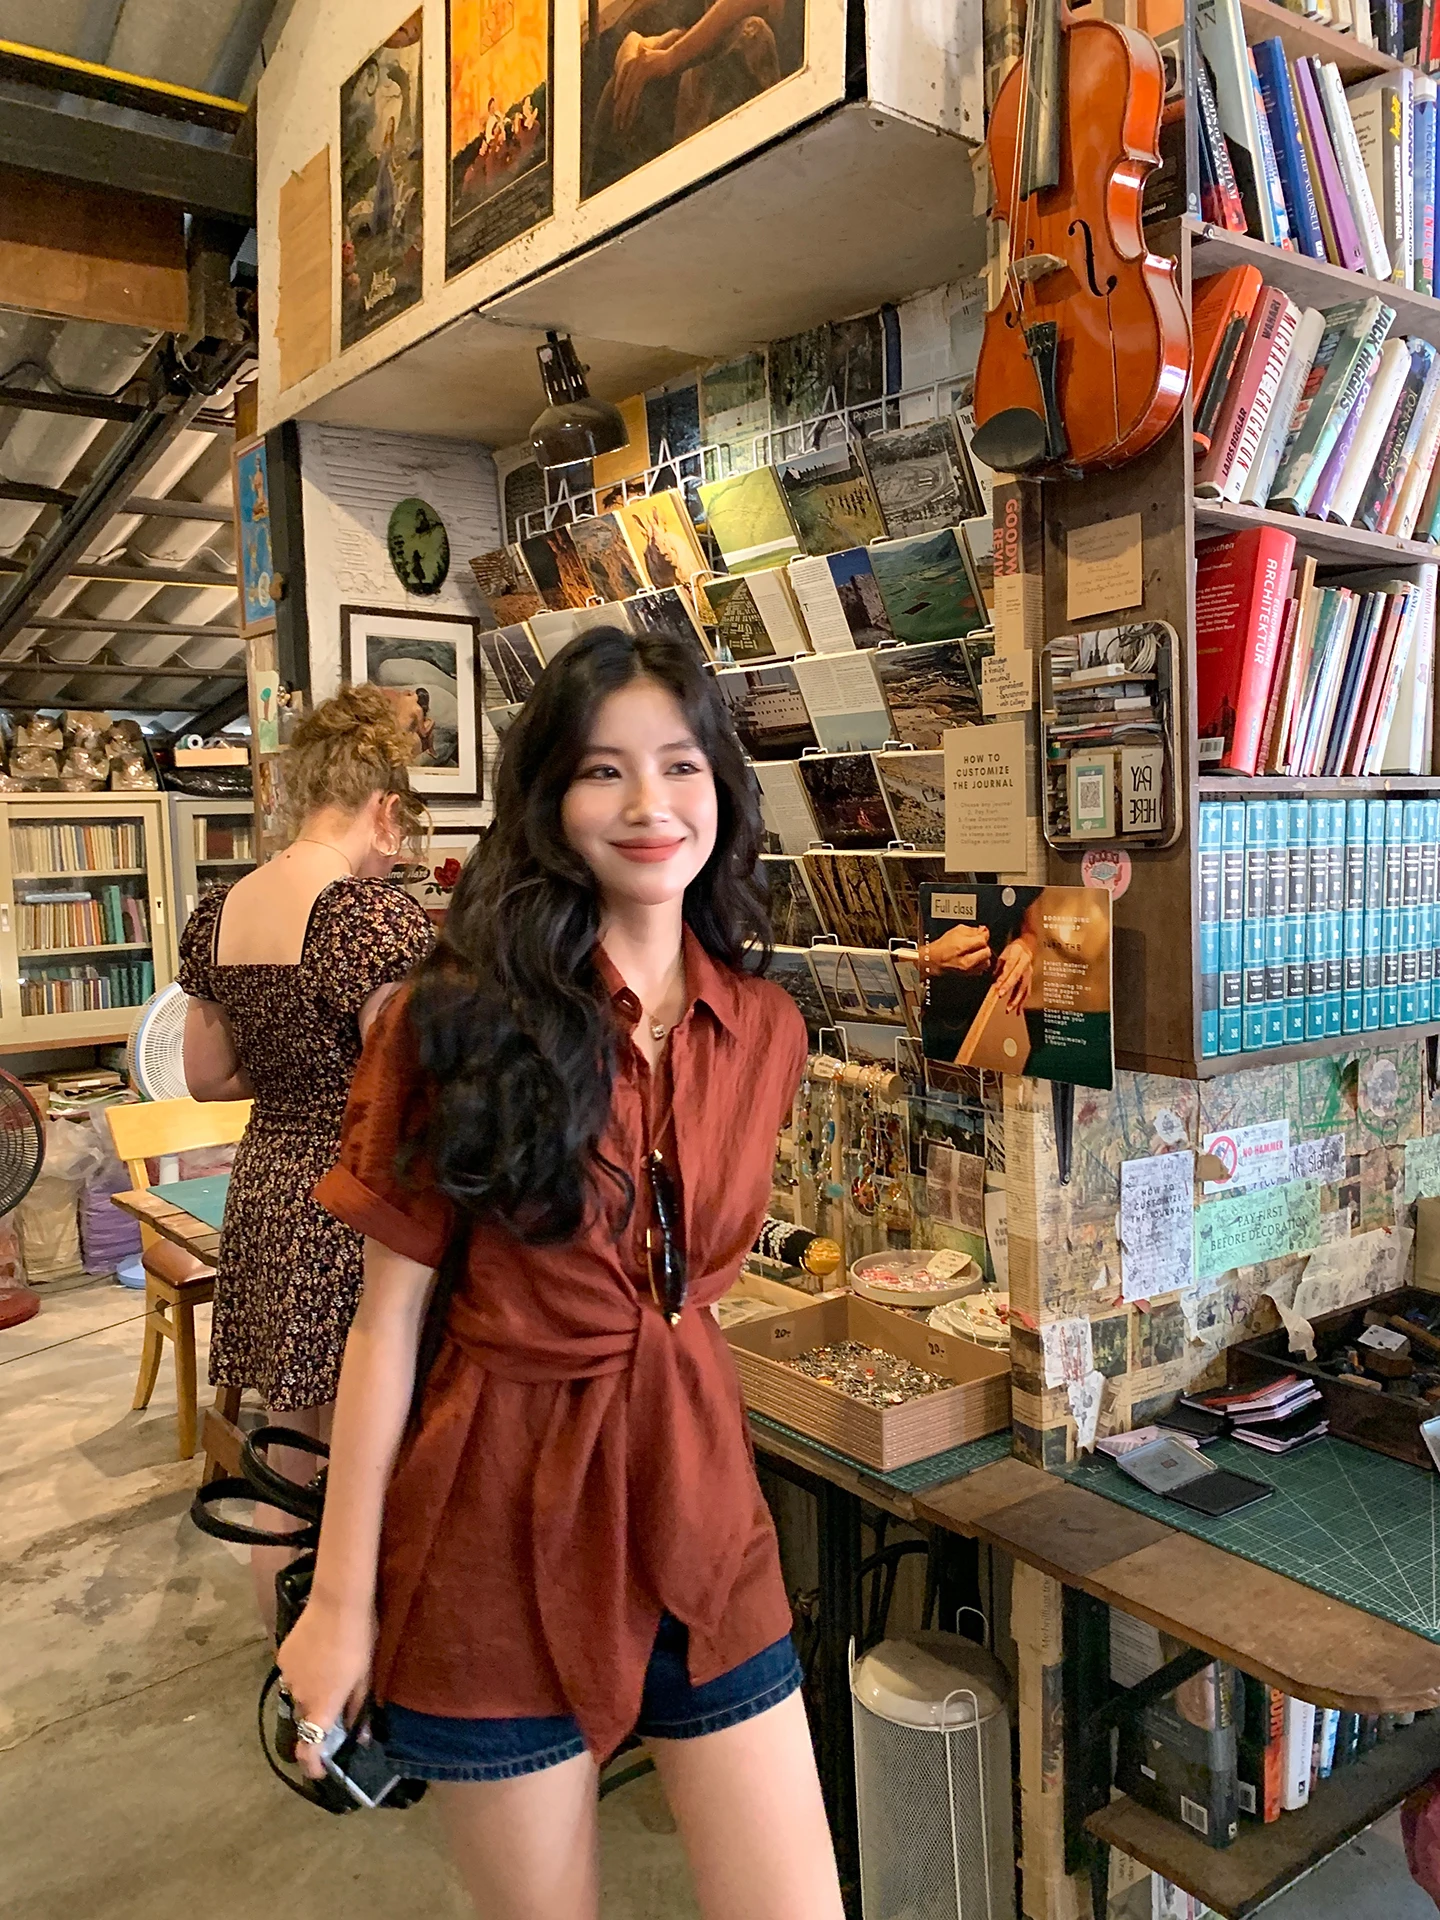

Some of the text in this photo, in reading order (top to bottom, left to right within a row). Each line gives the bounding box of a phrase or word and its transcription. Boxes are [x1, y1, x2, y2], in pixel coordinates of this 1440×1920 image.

[1198, 68, 1238, 200] THE GODS OF GOTHAM
[1424, 124, 1433, 178] TICKLING
[1304, 176, 1321, 231] YOURSELF
[1262, 299, 1282, 340] WAHARI
[1366, 304, 1393, 351] JACK
[1263, 312, 1298, 384] MICHAEL
[1339, 350, 1374, 412] HIGGINS
[1237, 387, 1271, 473] CRICHTON
[1383, 392, 1418, 491] JOHN SIMPSON
[1221, 447, 1236, 478] LAJOS
[1254, 558, 1278, 663] ARCHITEKTUR
[956, 766, 1009, 777] CUSTOMIZE
[964, 753, 1000, 764] HOW TO
[953, 779, 1013, 790] THE JOURNAL
[935, 899, 974, 915] Full class
[1242, 1140, 1284, 1158] NO HAMMER
[1210, 1216, 1311, 1251] BEFORE DECORATION
[1238, 1205, 1284, 1228] PAY FIRST
